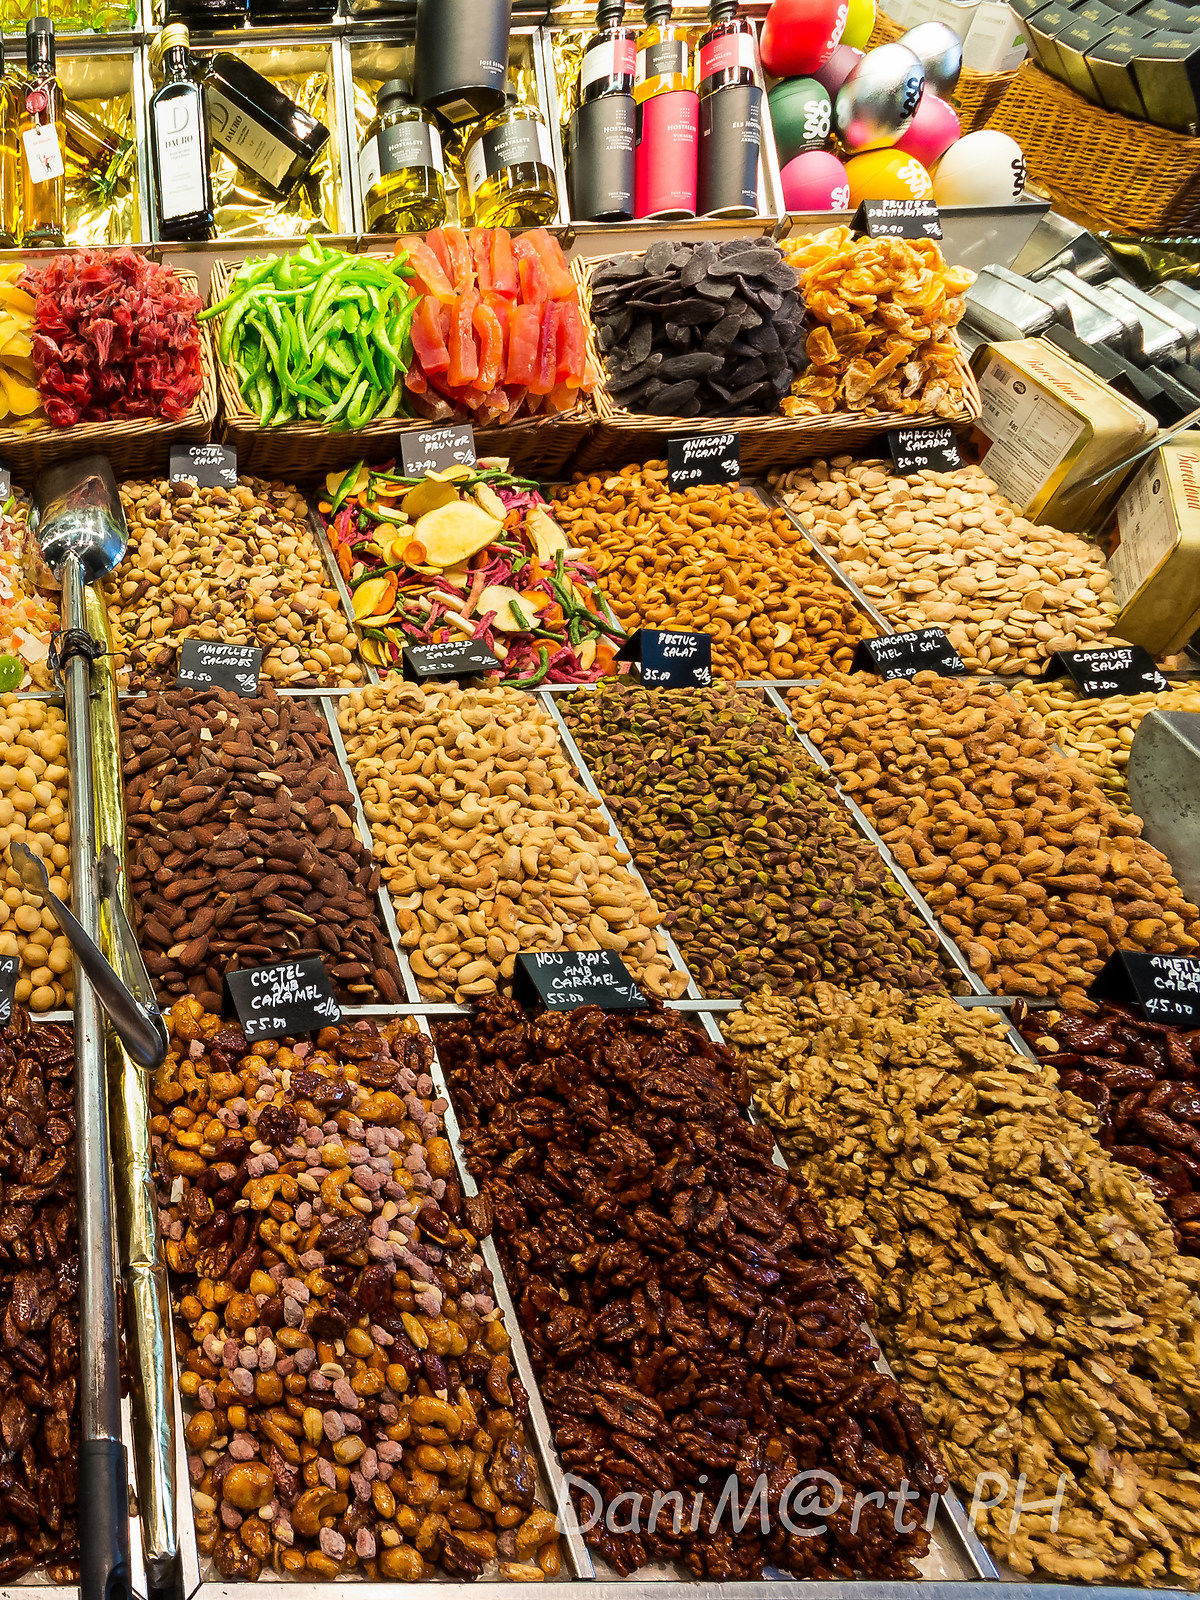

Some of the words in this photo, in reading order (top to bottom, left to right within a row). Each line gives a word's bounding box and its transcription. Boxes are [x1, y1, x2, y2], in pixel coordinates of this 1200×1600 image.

[224, 115, 243, 143] DAURO
[165, 135, 193, 149] DAURO
[871, 224, 904, 233] 29.90
[418, 429, 456, 442] COCTEL
[683, 434, 734, 451] ANACARD
[899, 428, 952, 443] MARCONA
[905, 438, 949, 452] SALADA
[193, 456, 225, 466] SALAT
[683, 445, 726, 464] PICANT
[898, 456, 928, 468] 26.90
[412, 640, 473, 654] ANACARD
[870, 632, 918, 650] ANACARD
[426, 648, 466, 660] SALAT
[662, 646, 697, 658] SALAT
[877, 648, 903, 661] MEL
[920, 640, 940, 652] SAL
[200, 655, 254, 668] SALADES
[1090, 660, 1133, 673] SALAT
[179, 669, 212, 682] 28.50
[886, 667, 917, 679] 35.00
[250, 963, 305, 987] COCTEL
[563, 965, 593, 978] AMB
[551, 972, 619, 990] CARAMEL
[251, 984, 323, 1010] CARAMEL
[546, 992, 584, 1005] 55.00
[1145, 998, 1194, 1014] 45.00
[245, 1016, 287, 1035] 55.00
